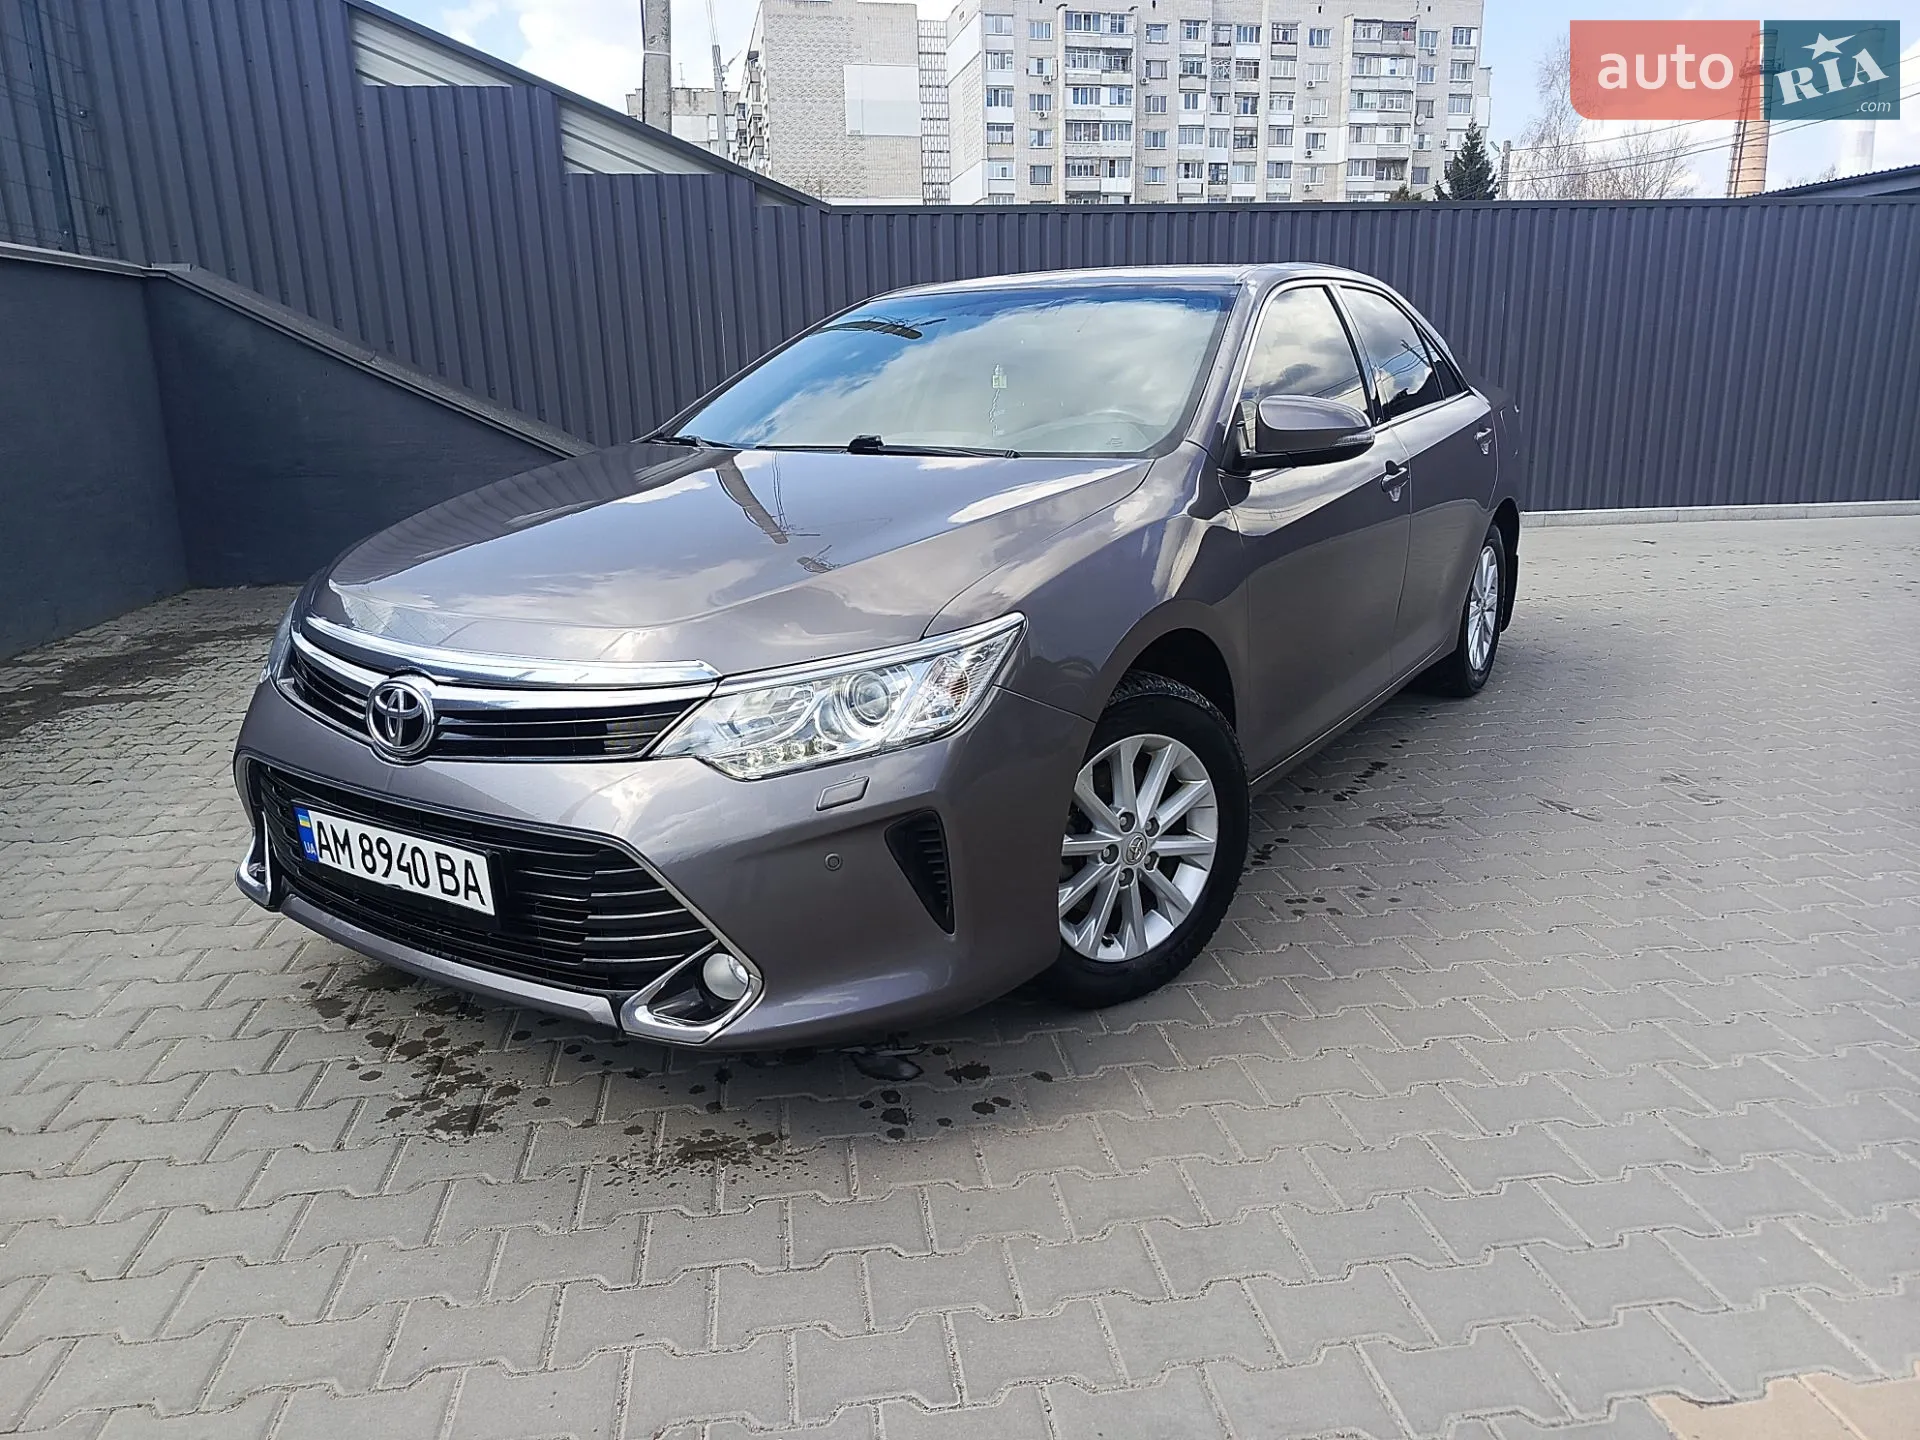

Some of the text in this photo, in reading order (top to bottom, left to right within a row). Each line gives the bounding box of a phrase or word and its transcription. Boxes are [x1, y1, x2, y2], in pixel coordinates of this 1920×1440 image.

[304, 842, 316, 855] UA
[316, 821, 487, 907] AM 8940 BA
